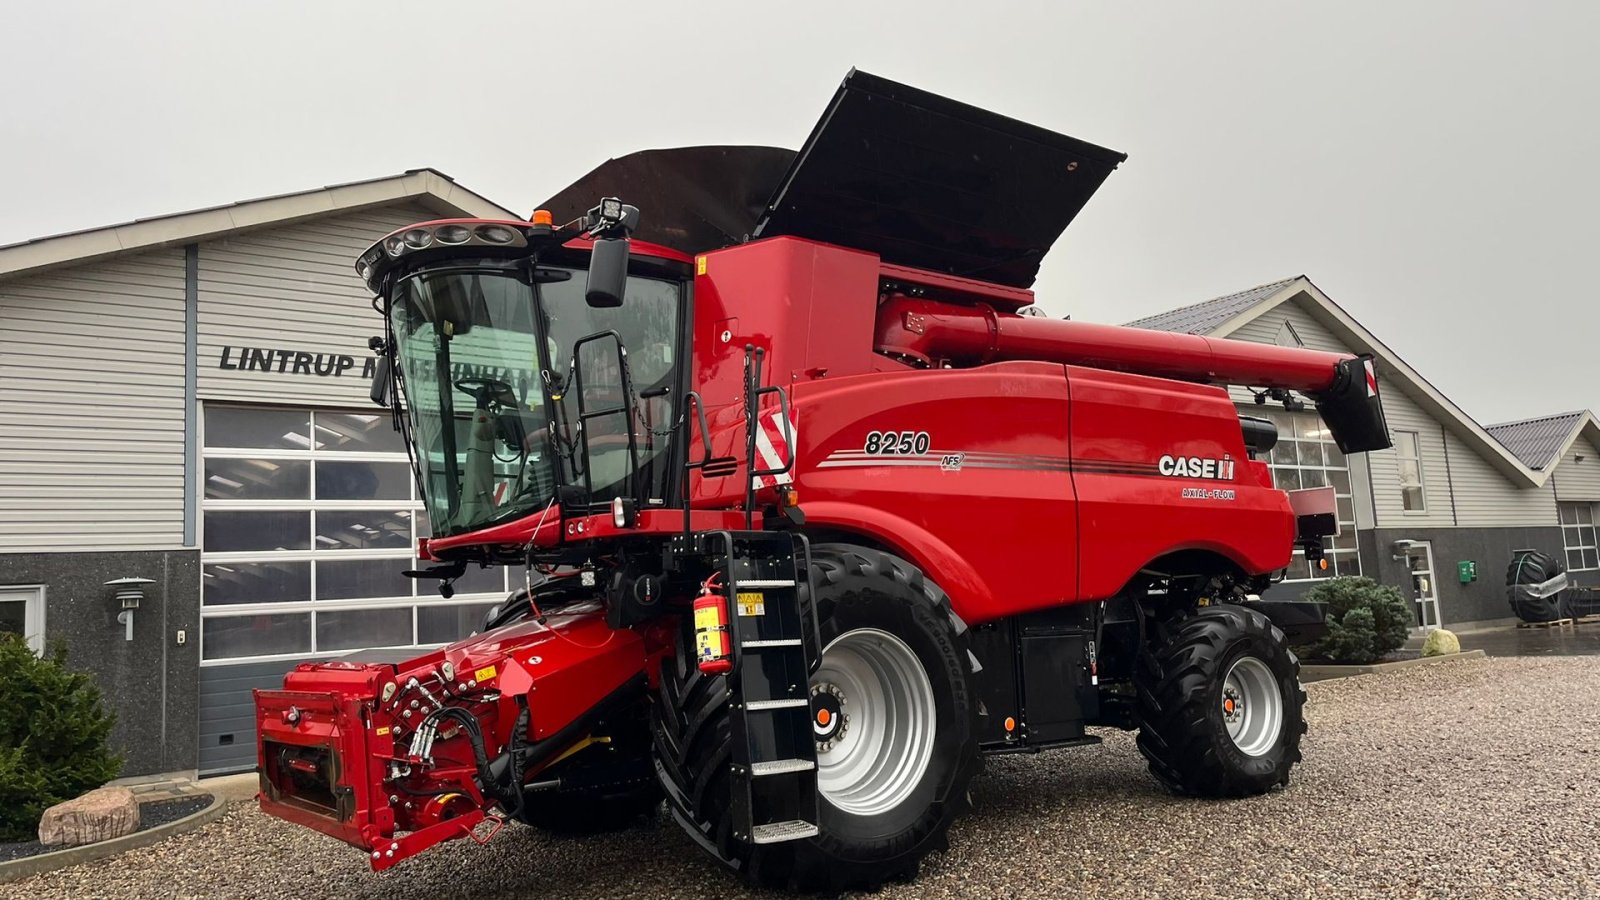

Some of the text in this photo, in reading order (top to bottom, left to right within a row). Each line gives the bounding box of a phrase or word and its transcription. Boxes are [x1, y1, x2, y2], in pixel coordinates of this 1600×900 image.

[219, 346, 354, 378] LINTRUP
[865, 431, 930, 455] 8250
[941, 454, 961, 466] AFS
[1158, 455, 1215, 478] CASE
